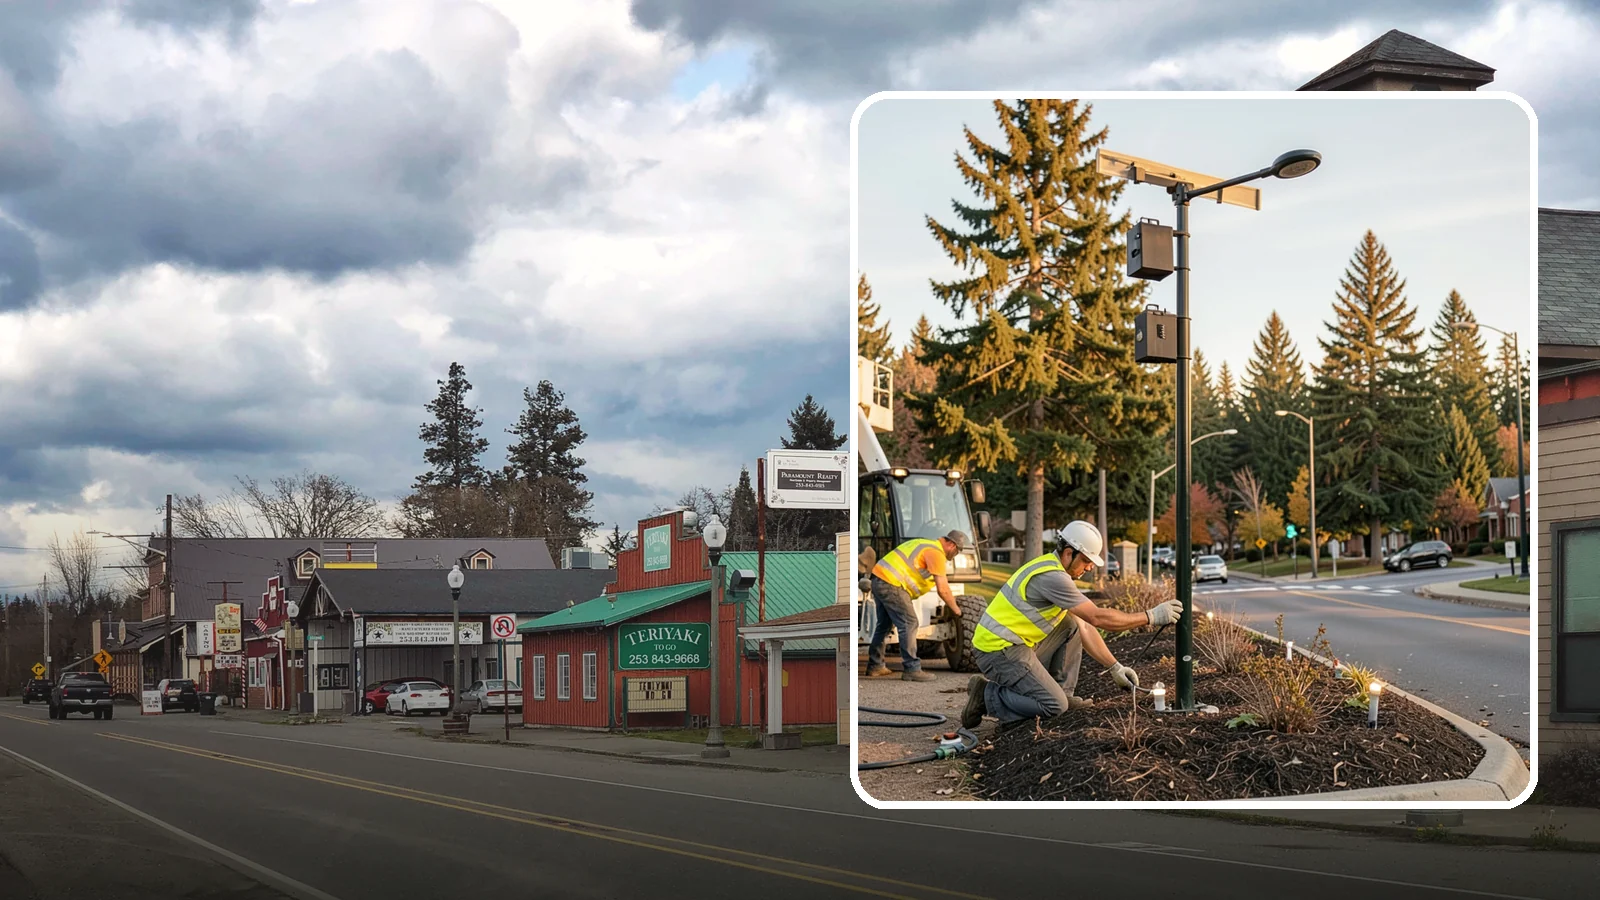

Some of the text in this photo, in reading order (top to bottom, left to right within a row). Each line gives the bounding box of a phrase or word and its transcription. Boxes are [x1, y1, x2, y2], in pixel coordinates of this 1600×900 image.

[781, 471, 839, 480] PARAMOUNT REALTY
[625, 627, 703, 646] TERIYAKI
[653, 643, 677, 651] TO GO
[628, 653, 700, 665] 253 843-9668
